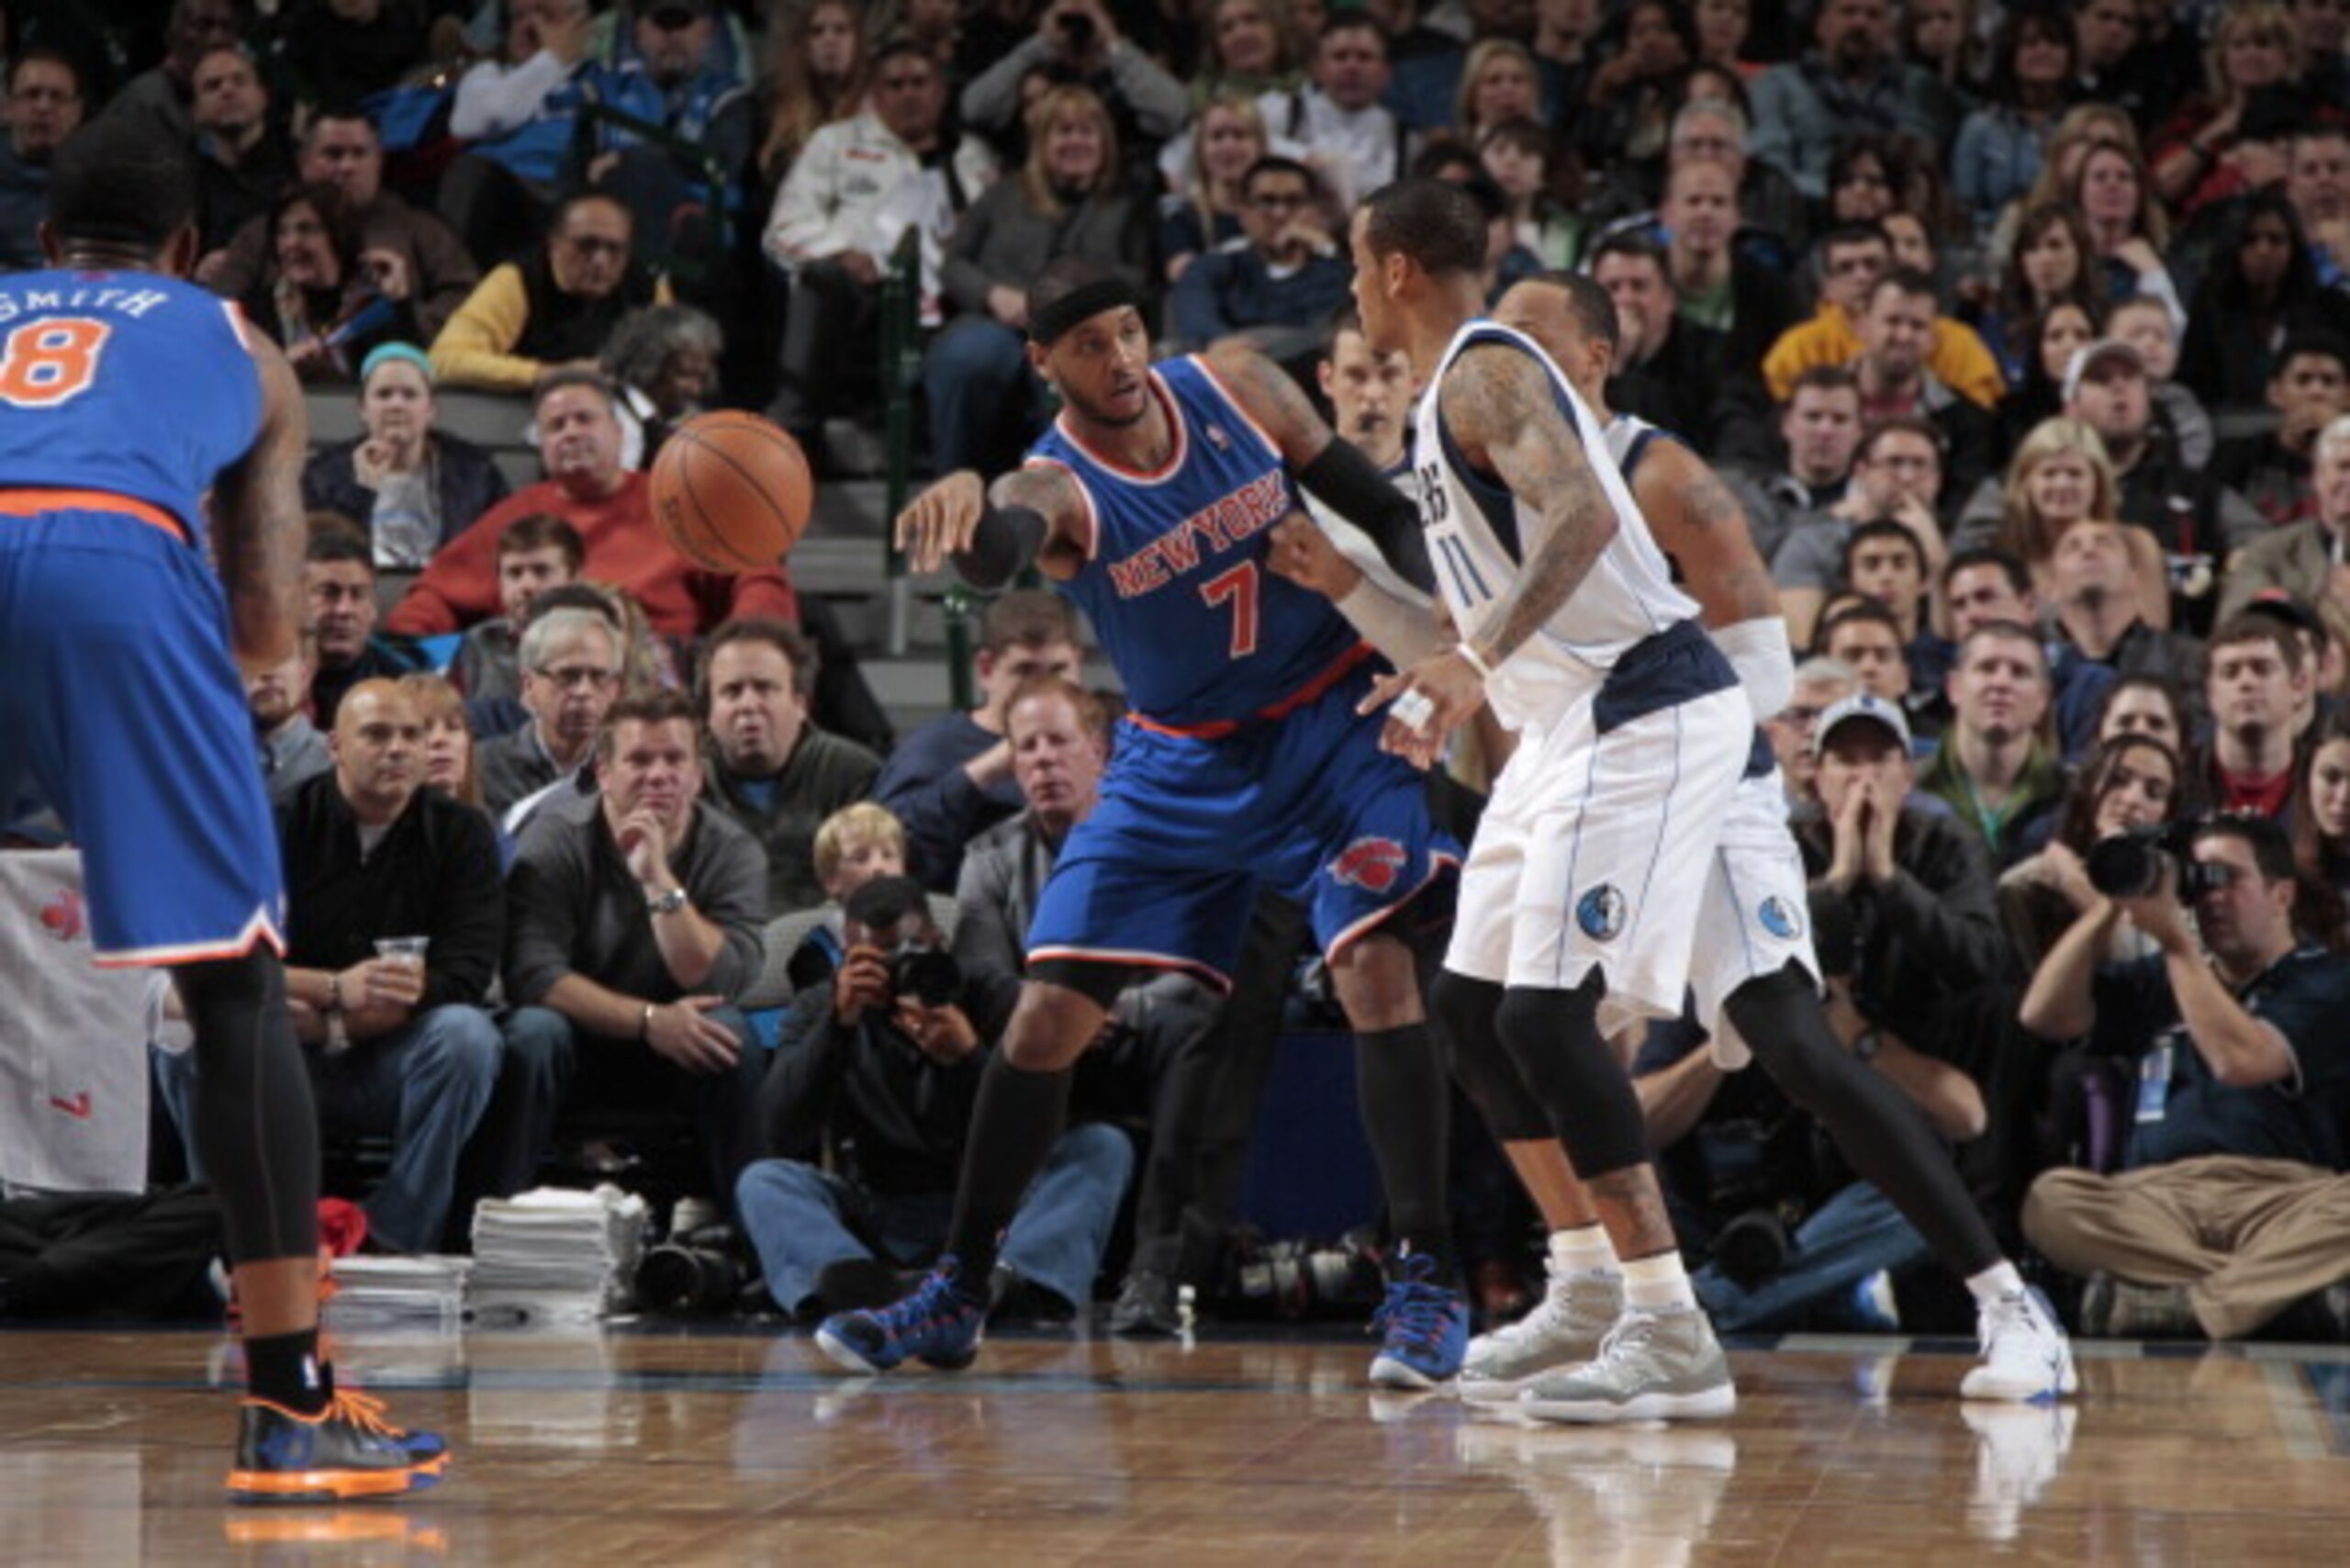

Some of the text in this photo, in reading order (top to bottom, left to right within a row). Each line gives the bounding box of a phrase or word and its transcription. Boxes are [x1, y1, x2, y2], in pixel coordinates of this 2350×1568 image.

[0, 316, 113, 407] 8
[1107, 467, 1291, 599] NEW YORK
[1437, 532, 1494, 609] 11
[1198, 558, 1259, 660] 7
